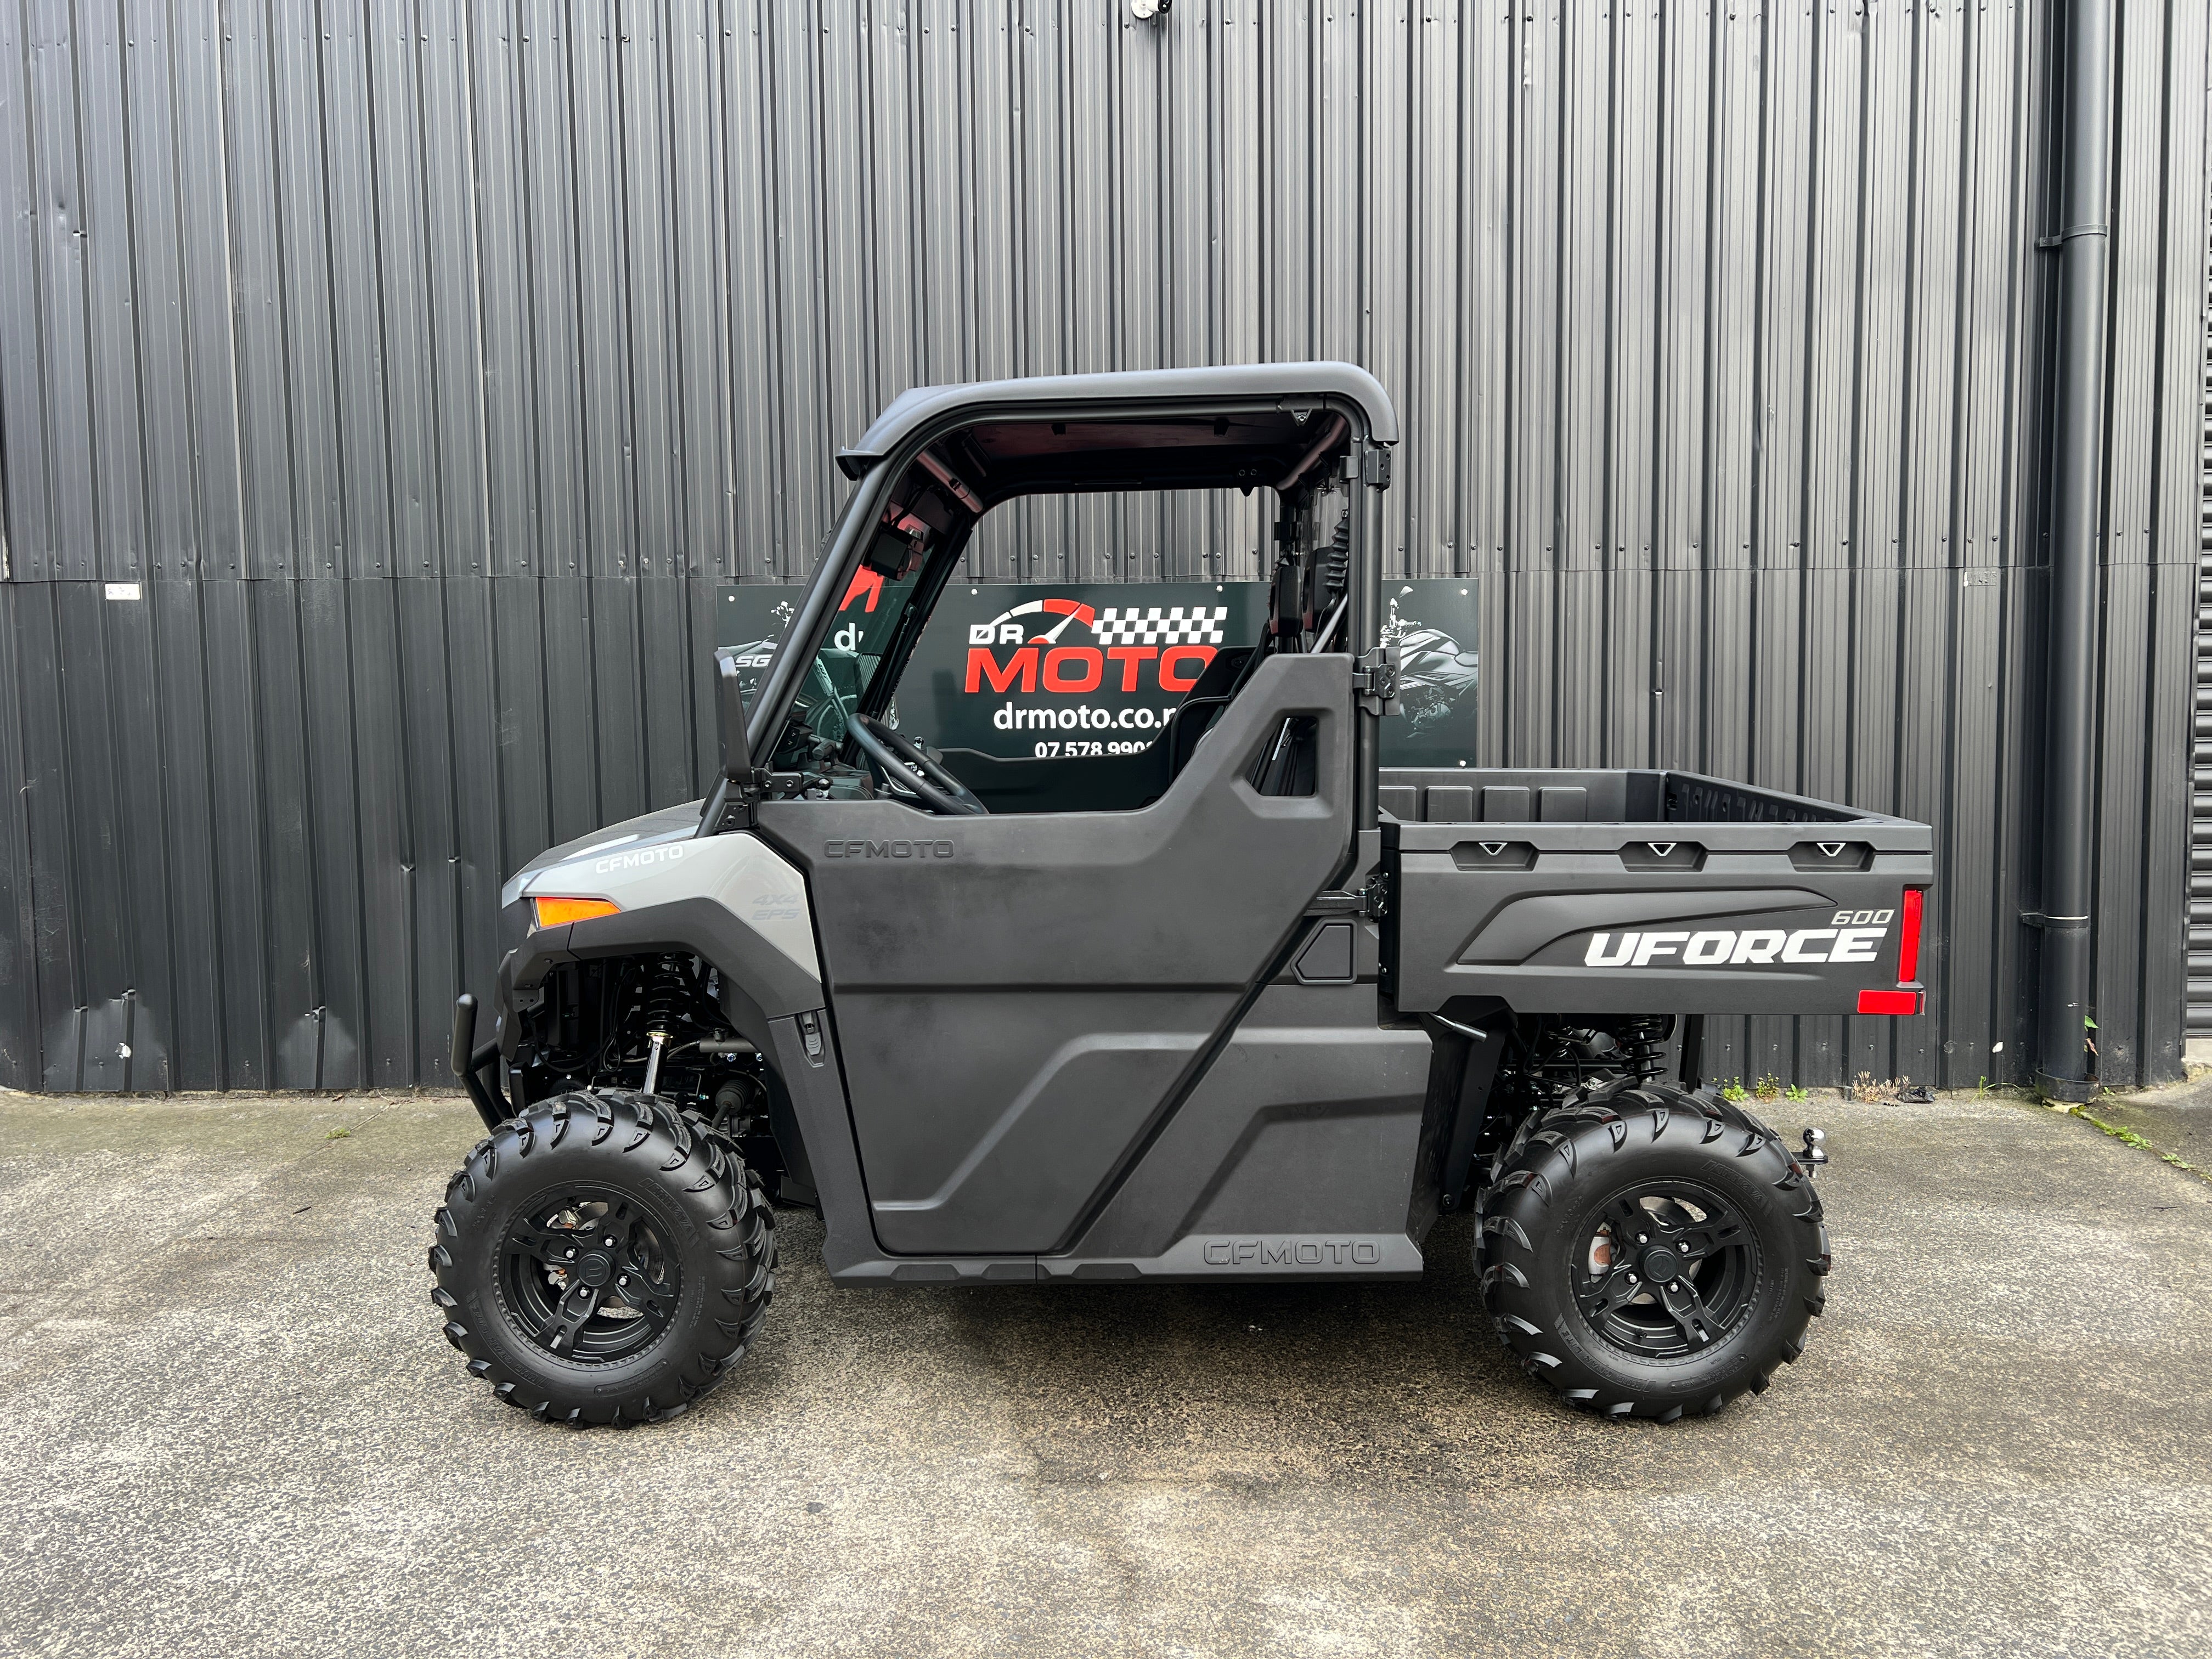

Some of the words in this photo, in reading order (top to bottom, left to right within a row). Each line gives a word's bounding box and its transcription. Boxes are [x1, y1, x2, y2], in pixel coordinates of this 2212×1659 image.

[969, 624, 1024, 644] DR
[964, 646, 1218, 692] MOTO
[1035, 742, 1060, 758] 07
[1065, 741, 1103, 757] 578
[824, 839, 955, 857] CFMOTO
[596, 845, 683, 873] CFMOTO
[752, 909, 801, 920] EPS
[1831, 909, 1894, 925] 600
[1584, 928, 1888, 966] UFORCE
[1203, 1240, 1380, 1265] CFMOTO
